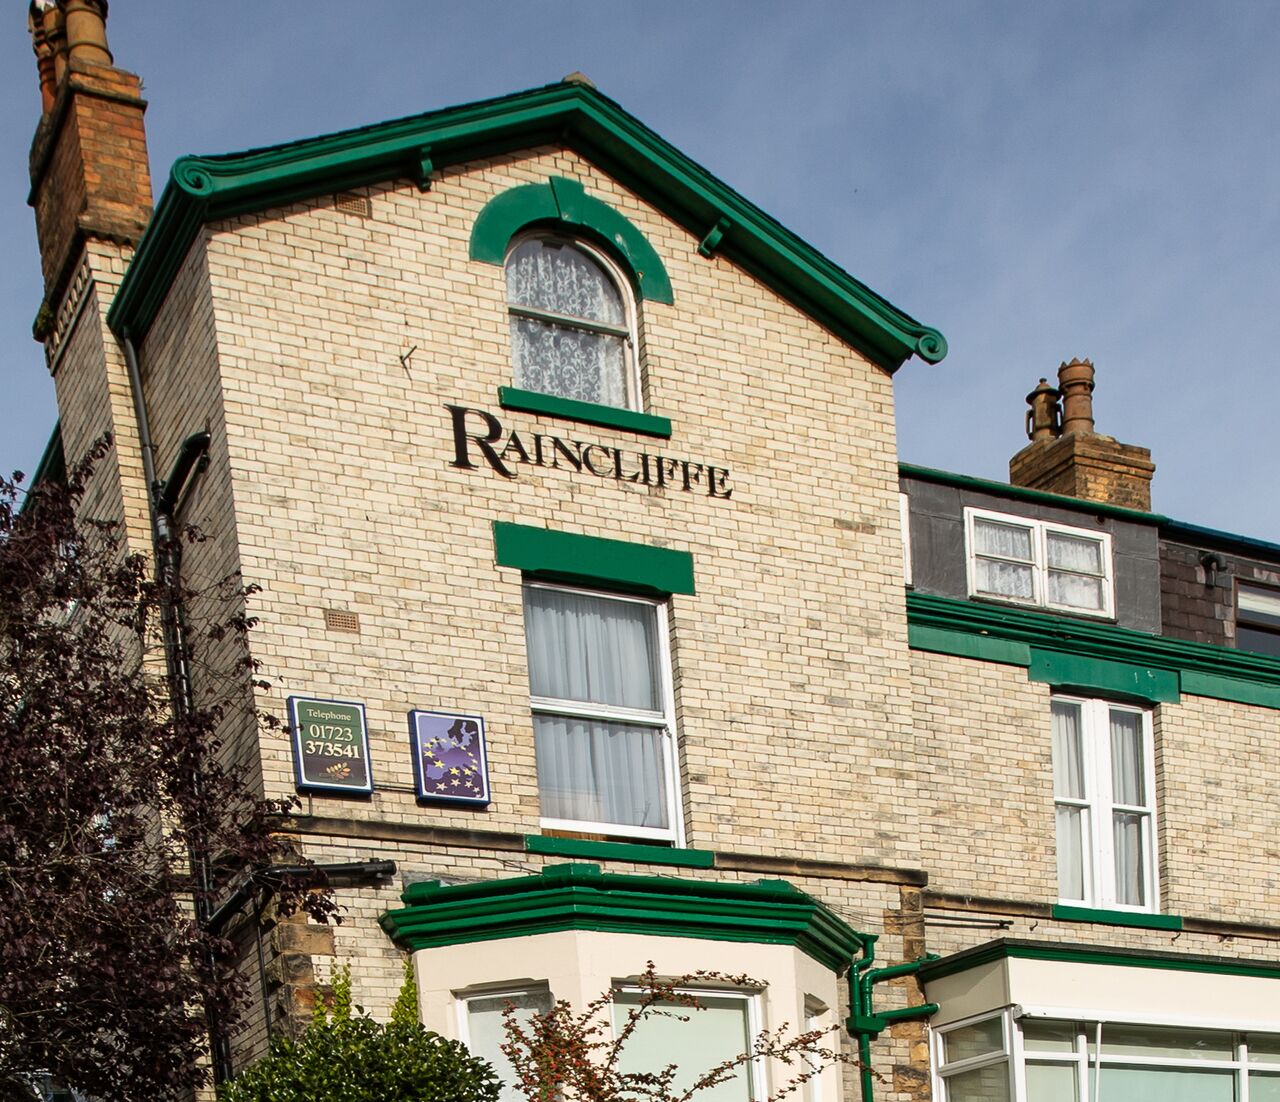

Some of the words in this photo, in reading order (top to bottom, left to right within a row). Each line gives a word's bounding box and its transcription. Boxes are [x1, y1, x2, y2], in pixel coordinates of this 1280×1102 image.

[443, 402, 733, 500] RAINCLIFFE
[306, 708, 352, 721] Telephone
[309, 724, 353, 742] 01723
[305, 740, 360, 759] 373541
